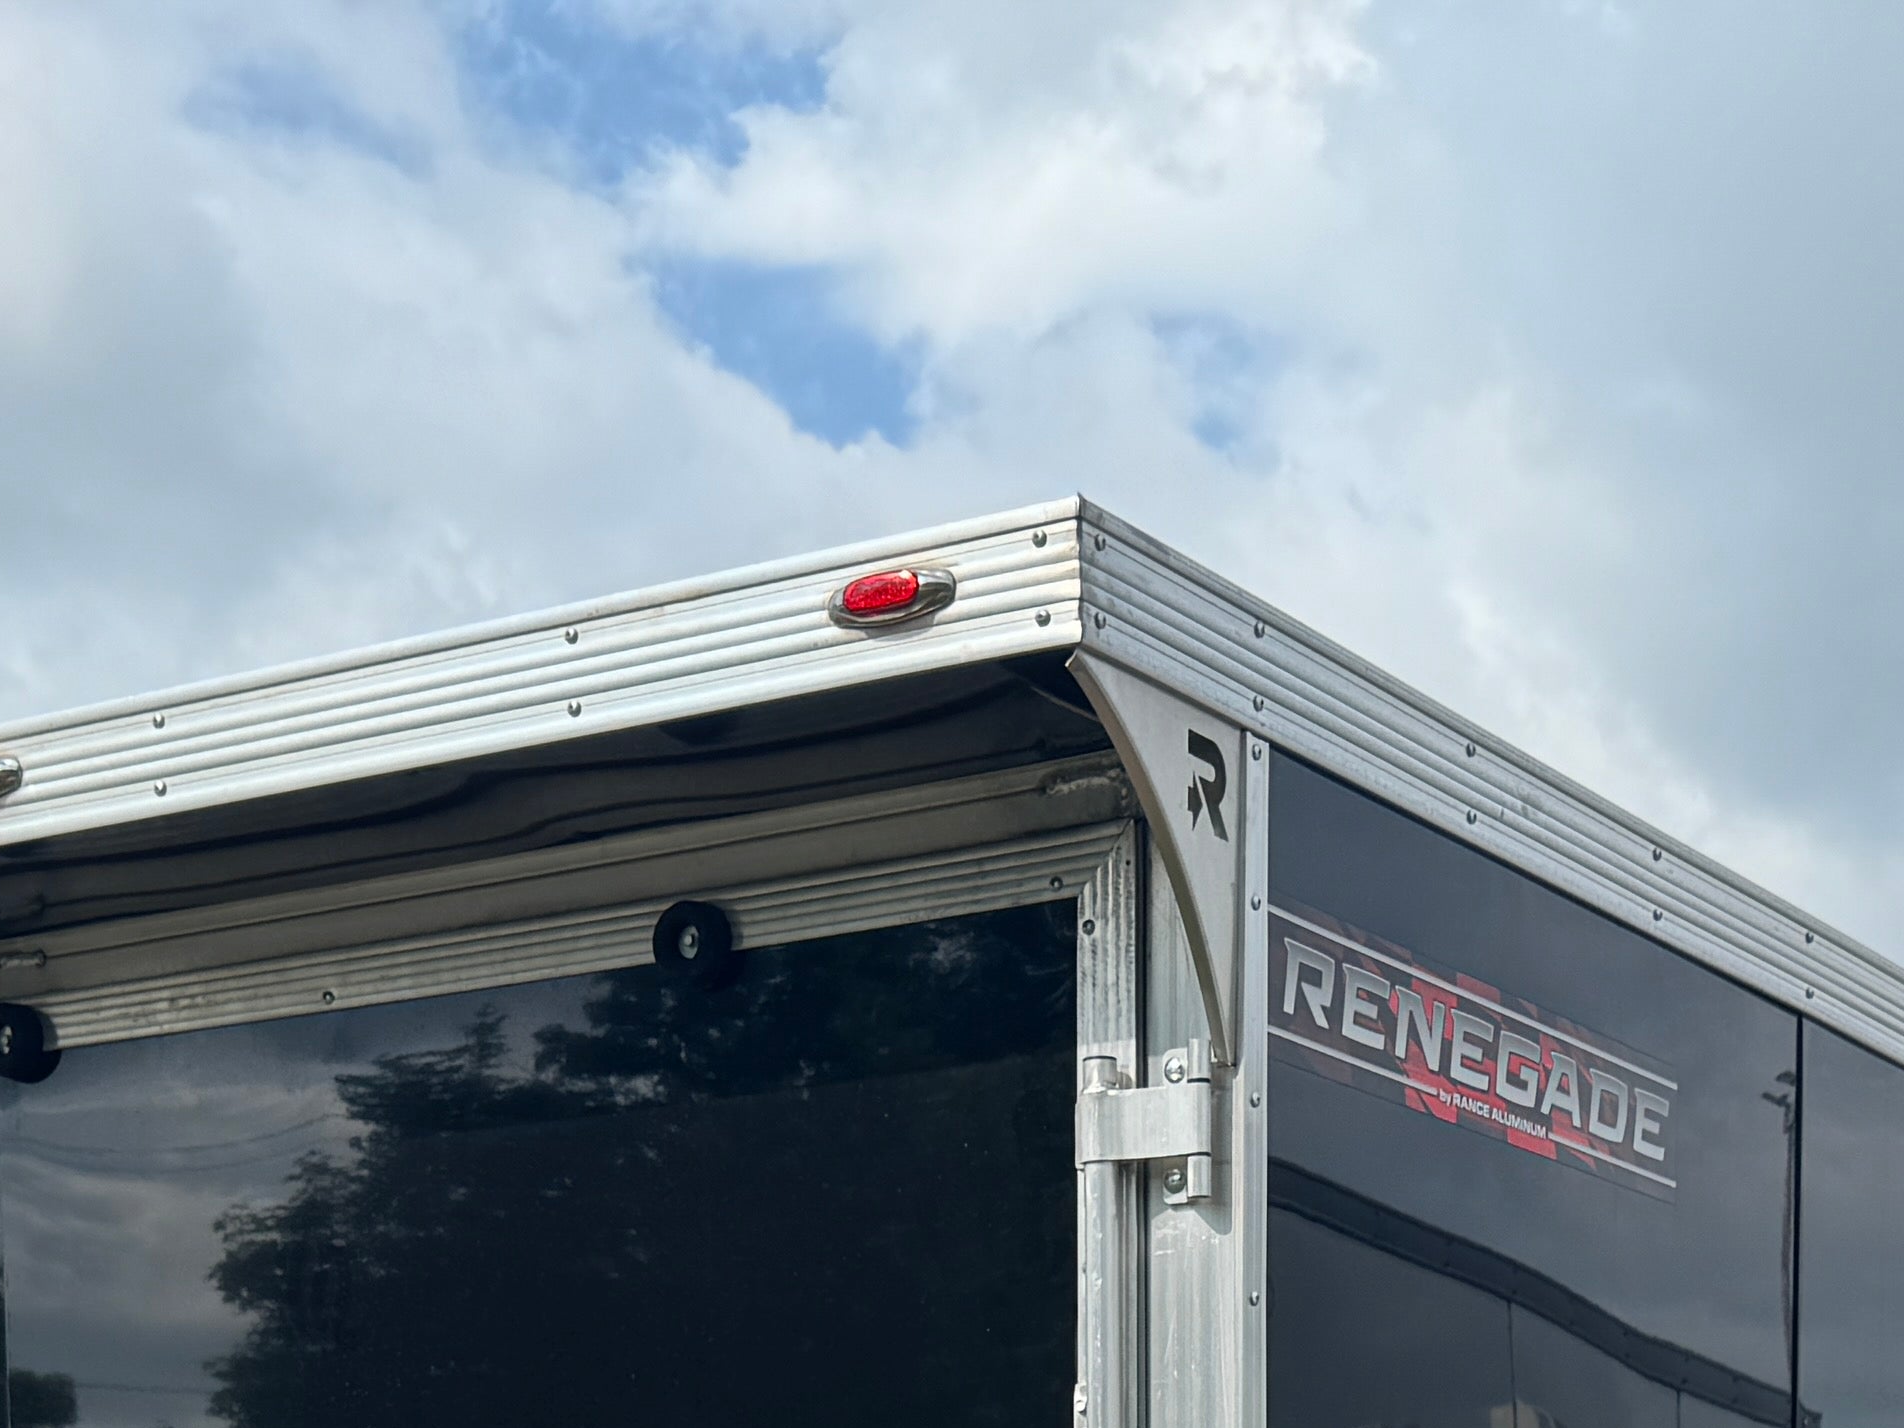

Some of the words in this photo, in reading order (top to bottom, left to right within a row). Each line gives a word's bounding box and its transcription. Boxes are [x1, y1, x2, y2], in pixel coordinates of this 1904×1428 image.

[1188, 728, 1229, 842] R
[1284, 937, 1670, 1161] RENEGADE
[1440, 1088, 1452, 1106] by
[1452, 1093, 1490, 1117] RANCE
[1491, 1108, 1547, 1139] ALUMINUM
